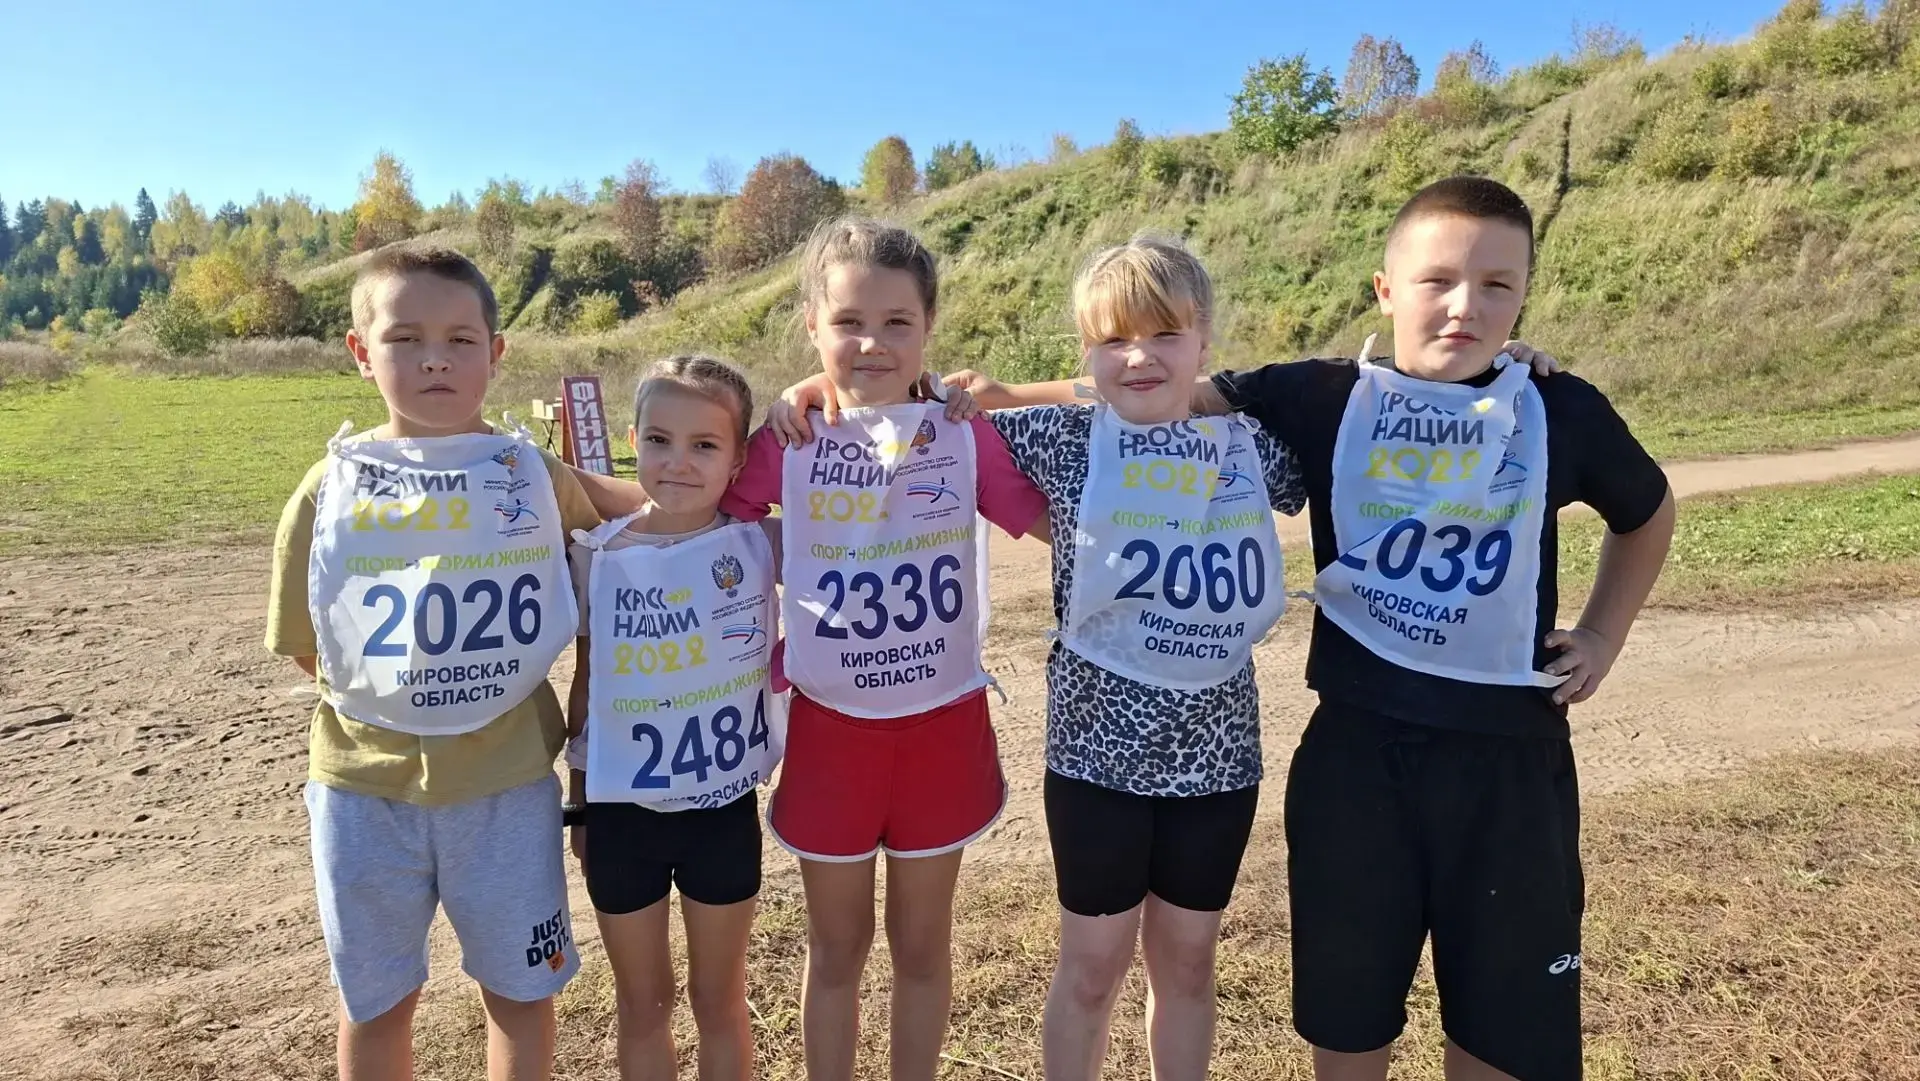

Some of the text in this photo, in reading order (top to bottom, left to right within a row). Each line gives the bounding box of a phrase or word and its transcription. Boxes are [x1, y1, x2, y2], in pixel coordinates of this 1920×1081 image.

[571, 382, 608, 474] ФИНИШ
[1371, 416, 1484, 446] НАЦИИ
[1366, 447, 1482, 484] 2022
[352, 497, 471, 532] 2022
[1112, 511, 1167, 529] СПОРТ
[498, 545, 552, 567] ЖИЗНИ
[811, 524, 971, 562] СПОРТ НОРМА ЖИЗНИ
[1114, 537, 1265, 613] 2060
[815, 554, 963, 639] 2336
[362, 573, 541, 657] 2026
[613, 606, 701, 639] НАЦИИ
[1139, 610, 1245, 637] КИРОВСКАЯ
[1368, 603, 1447, 645] ОБЛАСТЬ
[613, 635, 709, 675] 2022
[840, 637, 946, 668] КИРОВСКАЯ
[1145, 636, 1229, 659] ОБЛАСТЬ
[397, 659, 520, 686] КИРОВСКАЯ
[854, 664, 937, 689] ОБЛАСТЬ
[411, 685, 505, 708] ОБЛАСТЬ
[613, 698, 659, 713] СПОРТ
[672, 683, 732, 710] НОРМА
[631, 688, 769, 789] 2484
[531, 908, 563, 945] JUST
[526, 940, 556, 968] DO
